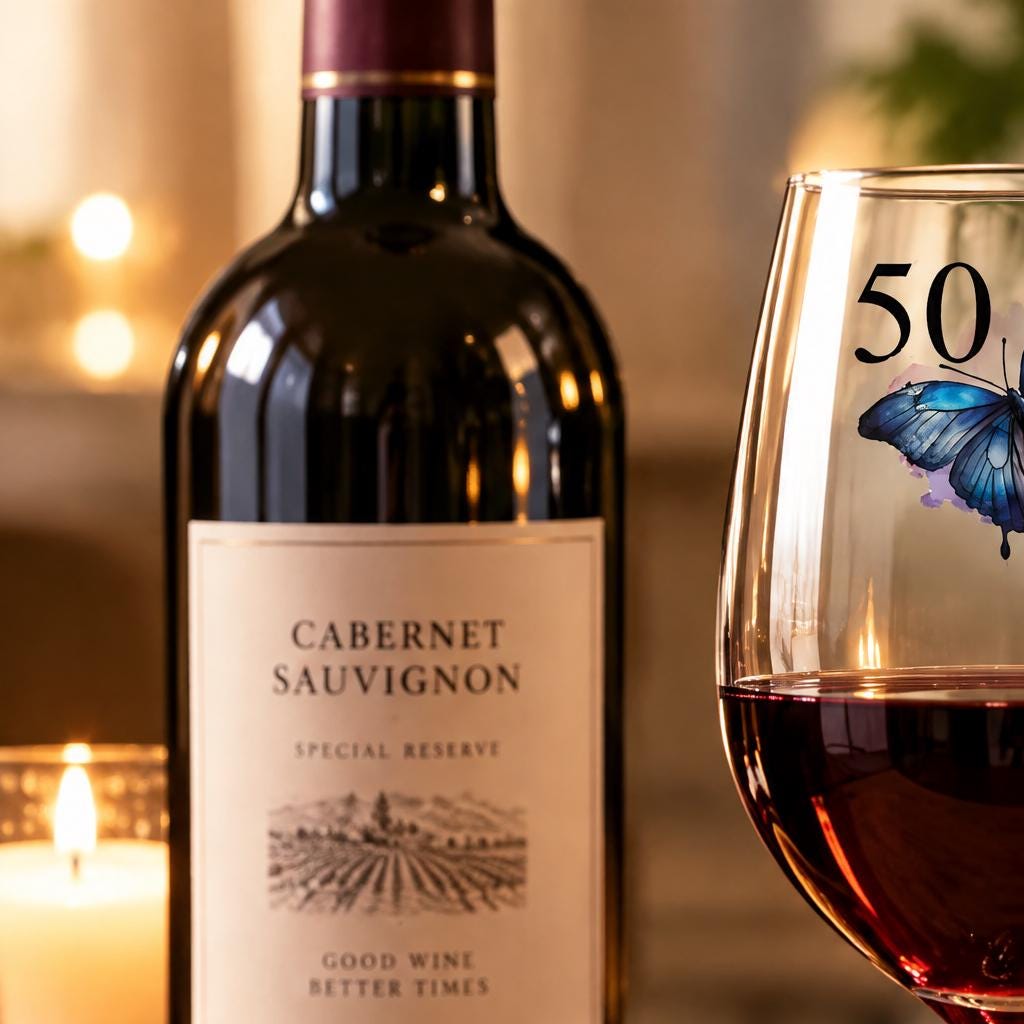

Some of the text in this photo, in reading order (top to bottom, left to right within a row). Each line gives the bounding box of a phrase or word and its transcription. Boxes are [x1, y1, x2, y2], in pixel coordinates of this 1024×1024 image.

[854, 261, 992, 364] 50
[291, 618, 506, 652] CABERNET
[272, 663, 522, 697] SAUVIGNON
[293, 740, 502, 760] SPECIAL RESERVE
[321, 950, 476, 972] GOOD WINE
[308, 976, 490, 998] BETTER TIMES
